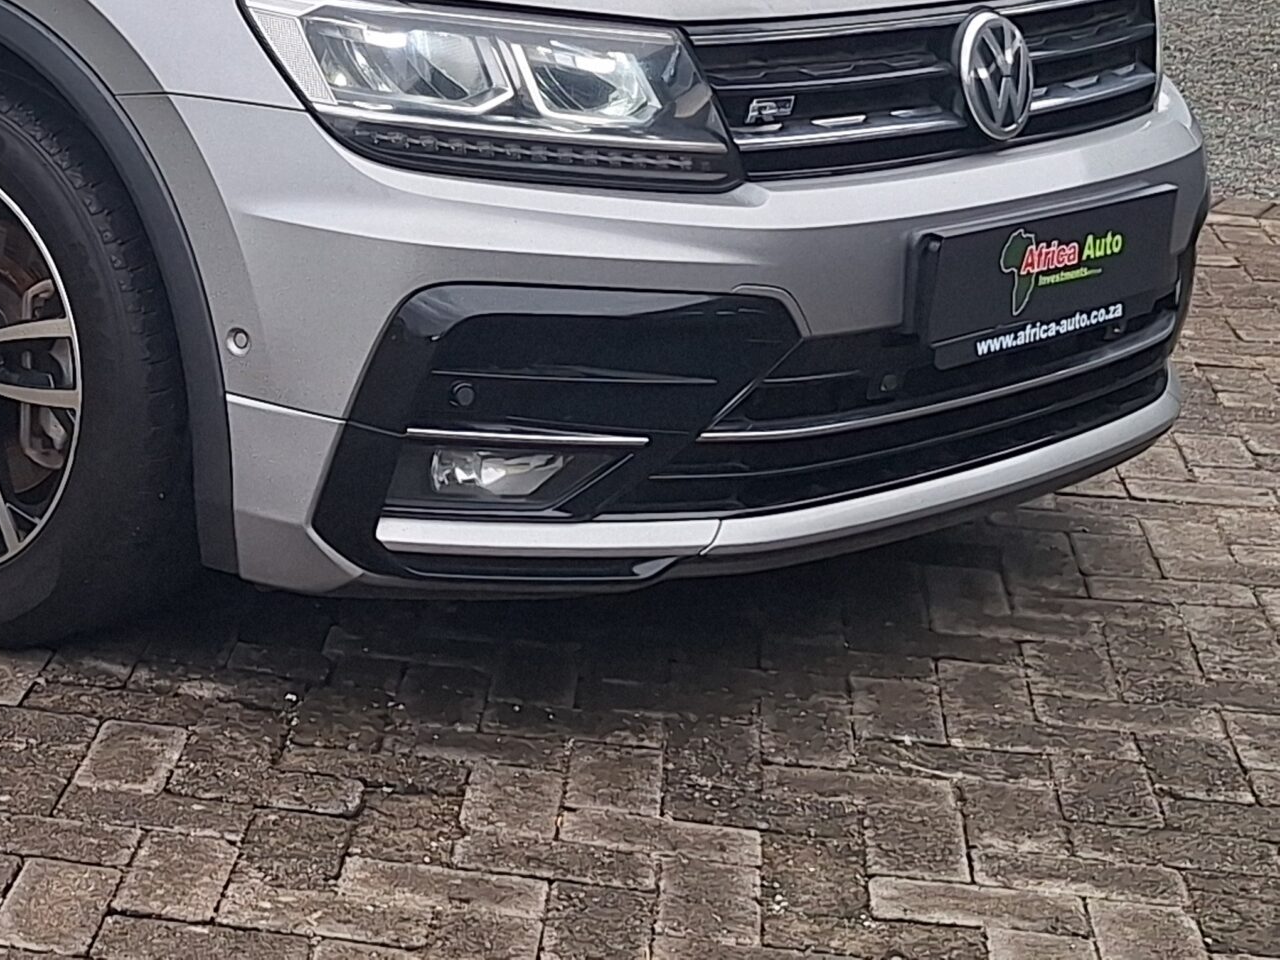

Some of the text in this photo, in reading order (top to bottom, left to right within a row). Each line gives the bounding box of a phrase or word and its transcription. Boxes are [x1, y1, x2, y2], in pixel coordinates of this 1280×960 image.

[1019, 230, 1123, 275] Africa Auto
[976, 302, 1124, 356] www.africa-auto.co.za
